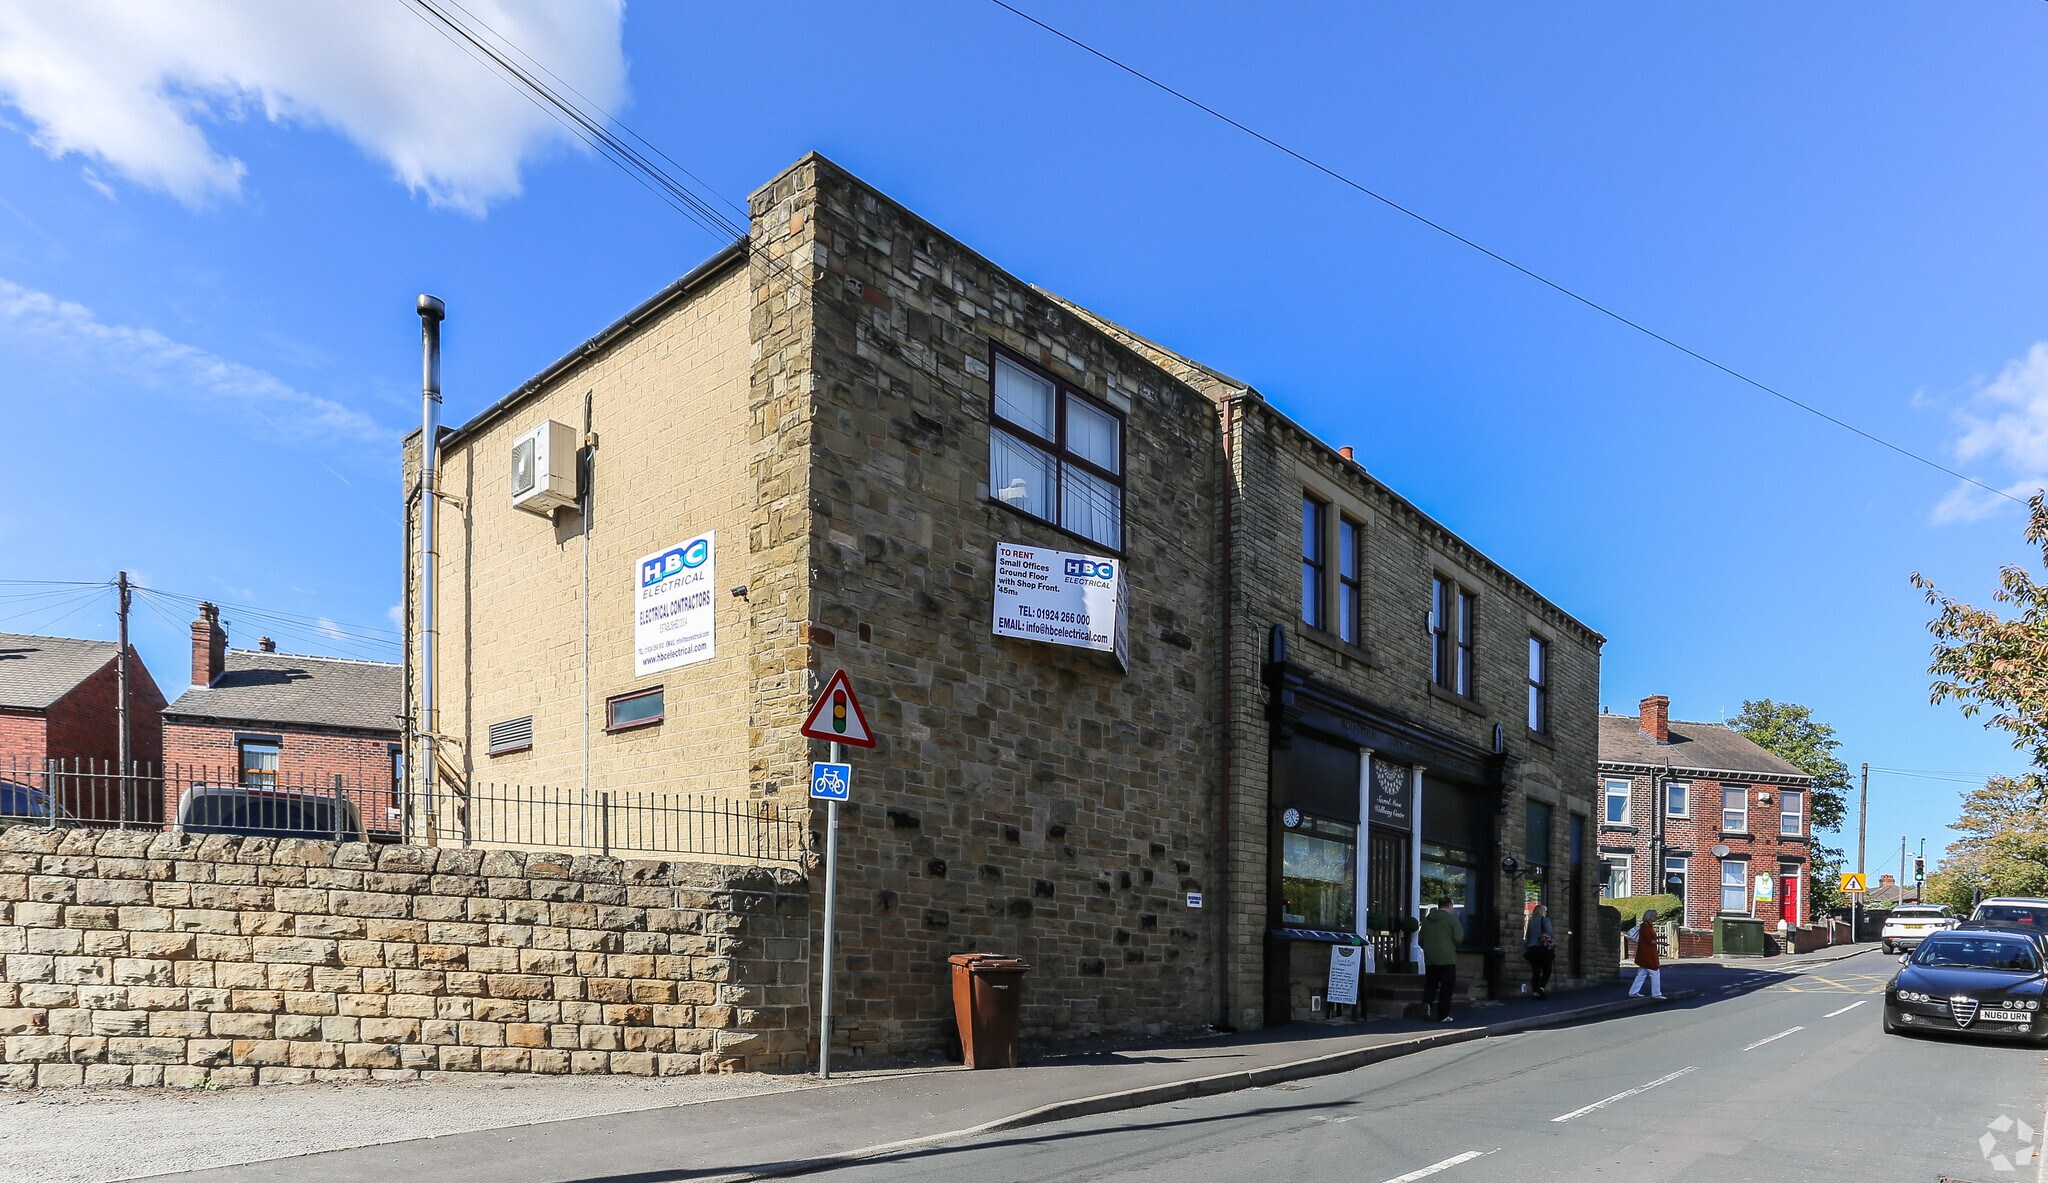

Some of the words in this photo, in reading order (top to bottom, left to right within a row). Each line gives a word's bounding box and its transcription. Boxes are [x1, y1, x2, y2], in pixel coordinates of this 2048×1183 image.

[642, 539, 708, 588] HBC
[1001, 548, 1011, 556] TO
[1013, 550, 1034, 560] RENT
[999, 568, 1027, 578] Ground
[1029, 571, 1049, 582] Floor
[1000, 558, 1021, 568] Small
[1022, 561, 1050, 572] Offices
[1065, 559, 1113, 580] HBC
[643, 571, 705, 600] ELECTRICAL
[999, 577, 1015, 586] with
[1017, 580, 1036, 590] Shop
[1038, 583, 1060, 593] Front.
[1064, 577, 1111, 589] ELECTRICAL
[640, 603, 669, 625] ELECTRICAL
[670, 590, 710, 616] CONTRACTORS
[1019, 605, 1035, 618] TEL:
[1036, 608, 1059, 621] 01924
[1061, 611, 1075, 624] 266
[1076, 613, 1090, 626] 000
[999, 617, 1025, 631] EMAIL:
[1026, 621, 1108, 644] info@hbcelectrical.com
[642, 642, 707, 666] www.hbcelectrical.com
[1984, 1011, 2009, 1020] NU60
[2010, 1012, 2028, 1021] URN
